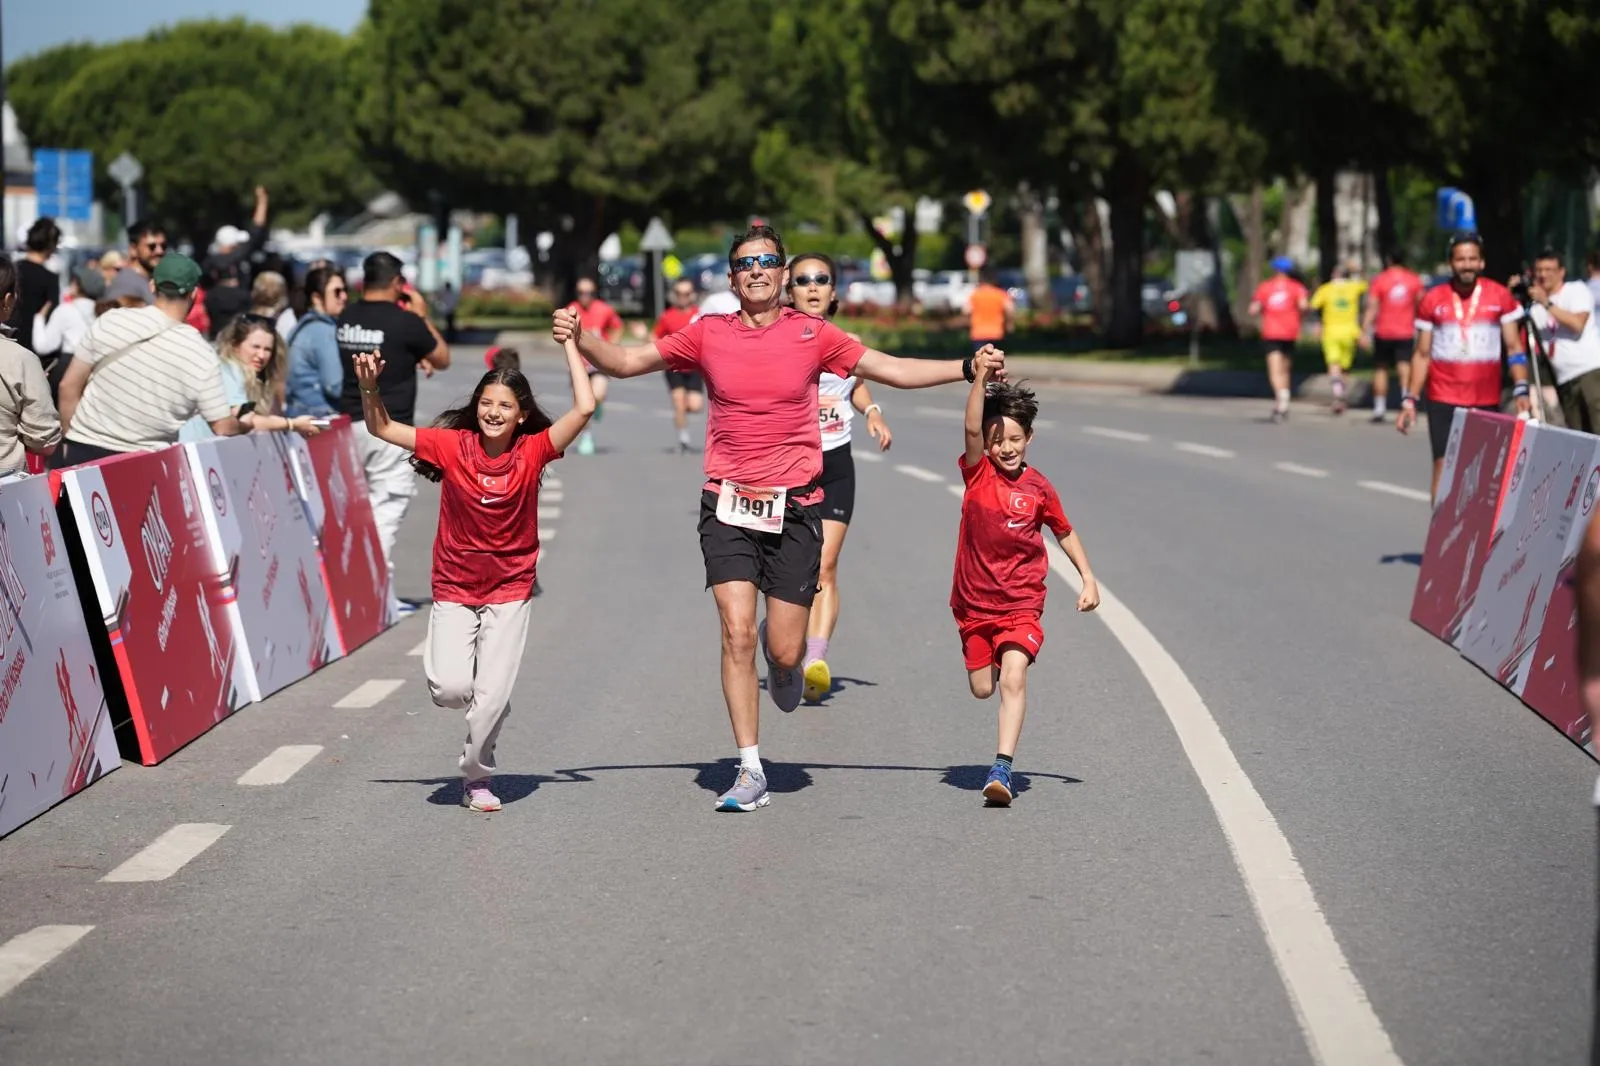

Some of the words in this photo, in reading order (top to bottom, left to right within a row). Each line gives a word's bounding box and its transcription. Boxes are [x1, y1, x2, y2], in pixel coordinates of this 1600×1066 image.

[819, 407, 839, 422] 54
[730, 494, 774, 518] 1991
[141, 484, 175, 595] OYAK
